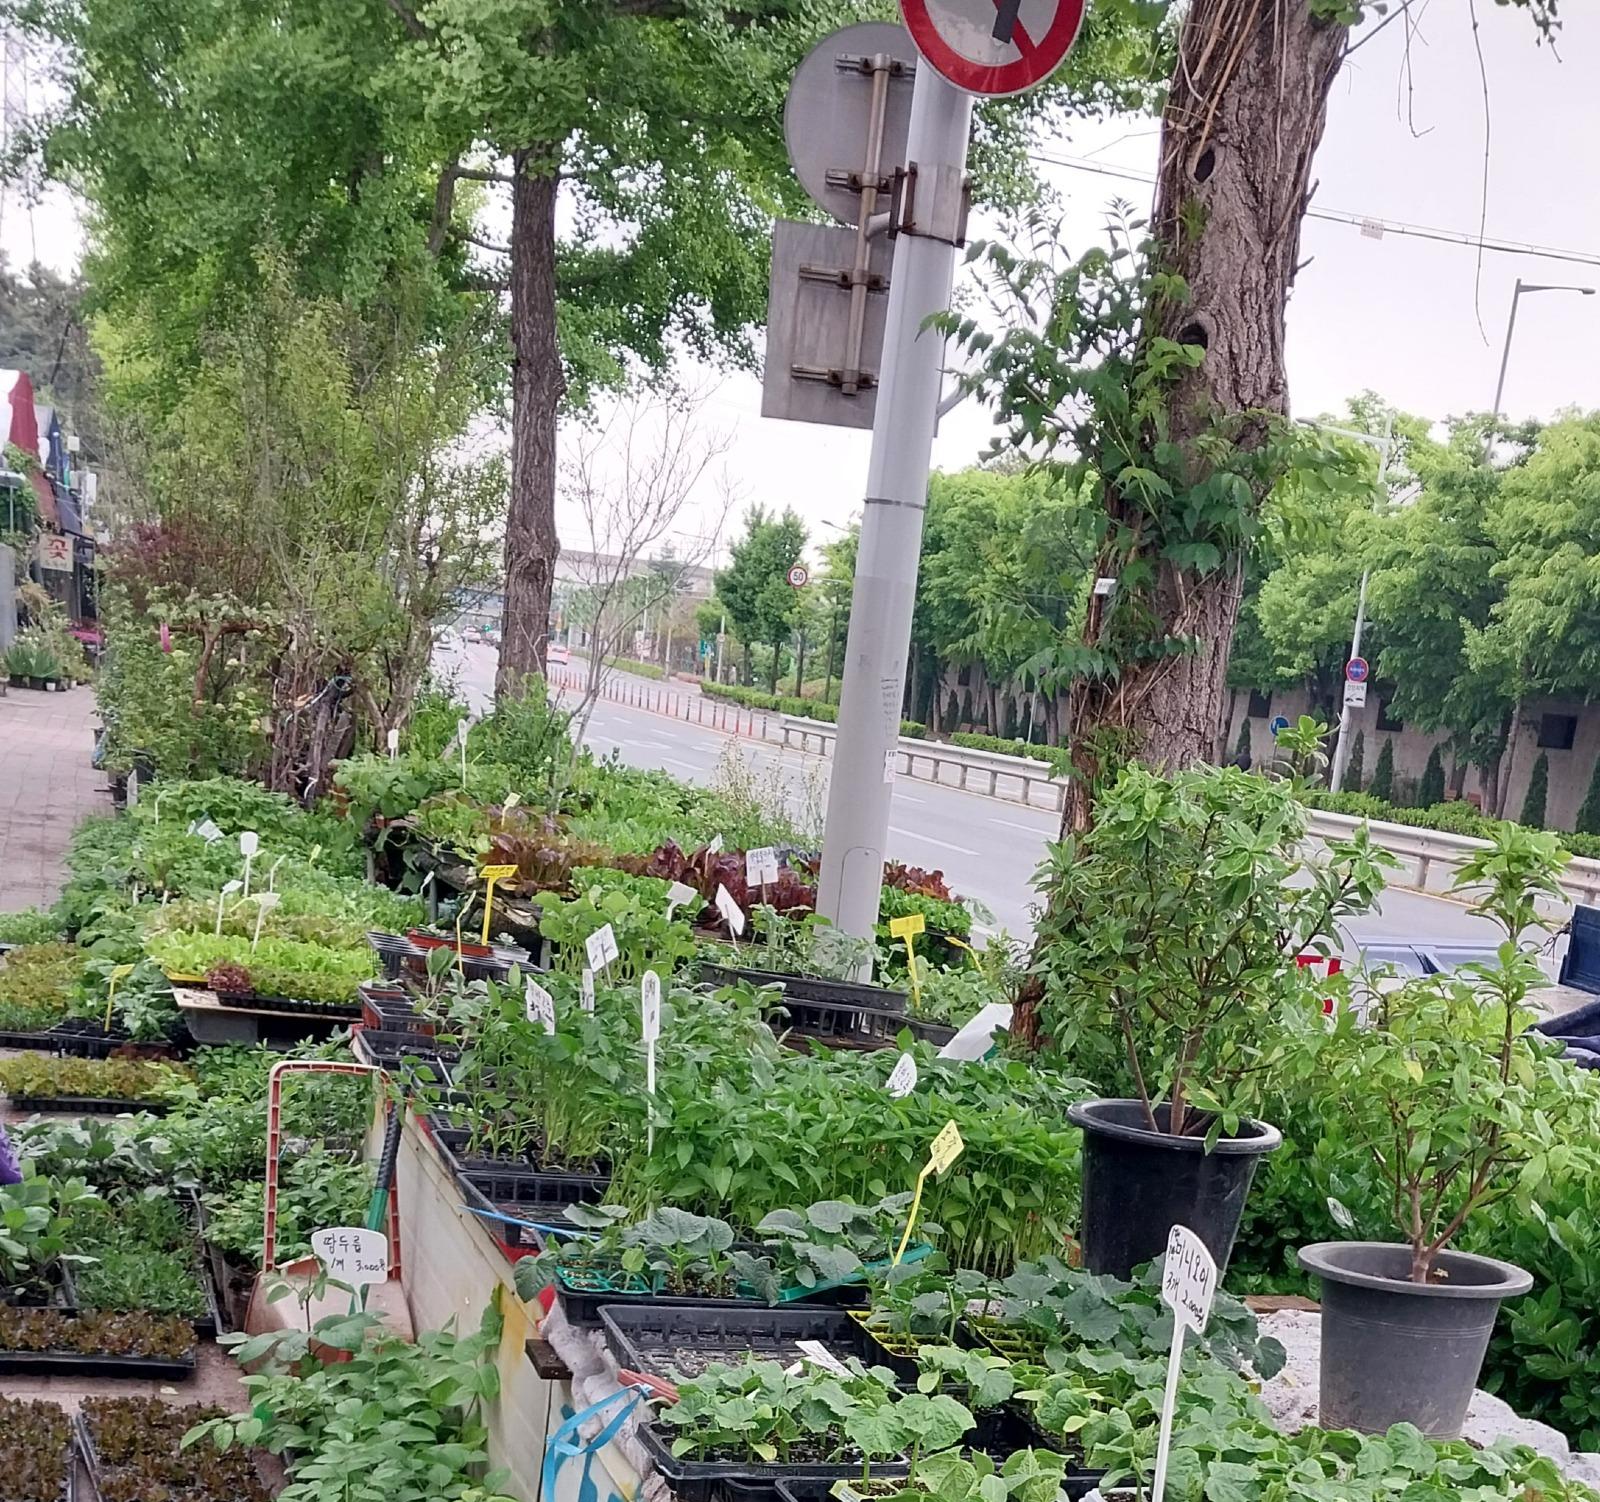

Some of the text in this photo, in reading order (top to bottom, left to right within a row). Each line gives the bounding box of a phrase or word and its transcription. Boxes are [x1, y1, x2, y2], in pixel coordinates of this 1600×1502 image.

[793, 571, 804, 581] 50
[323, 1232, 361, 1254] 땅두릅
[1175, 1239, 1210, 1297] 미니오이
[1166, 1271, 1180, 1302] 3개
